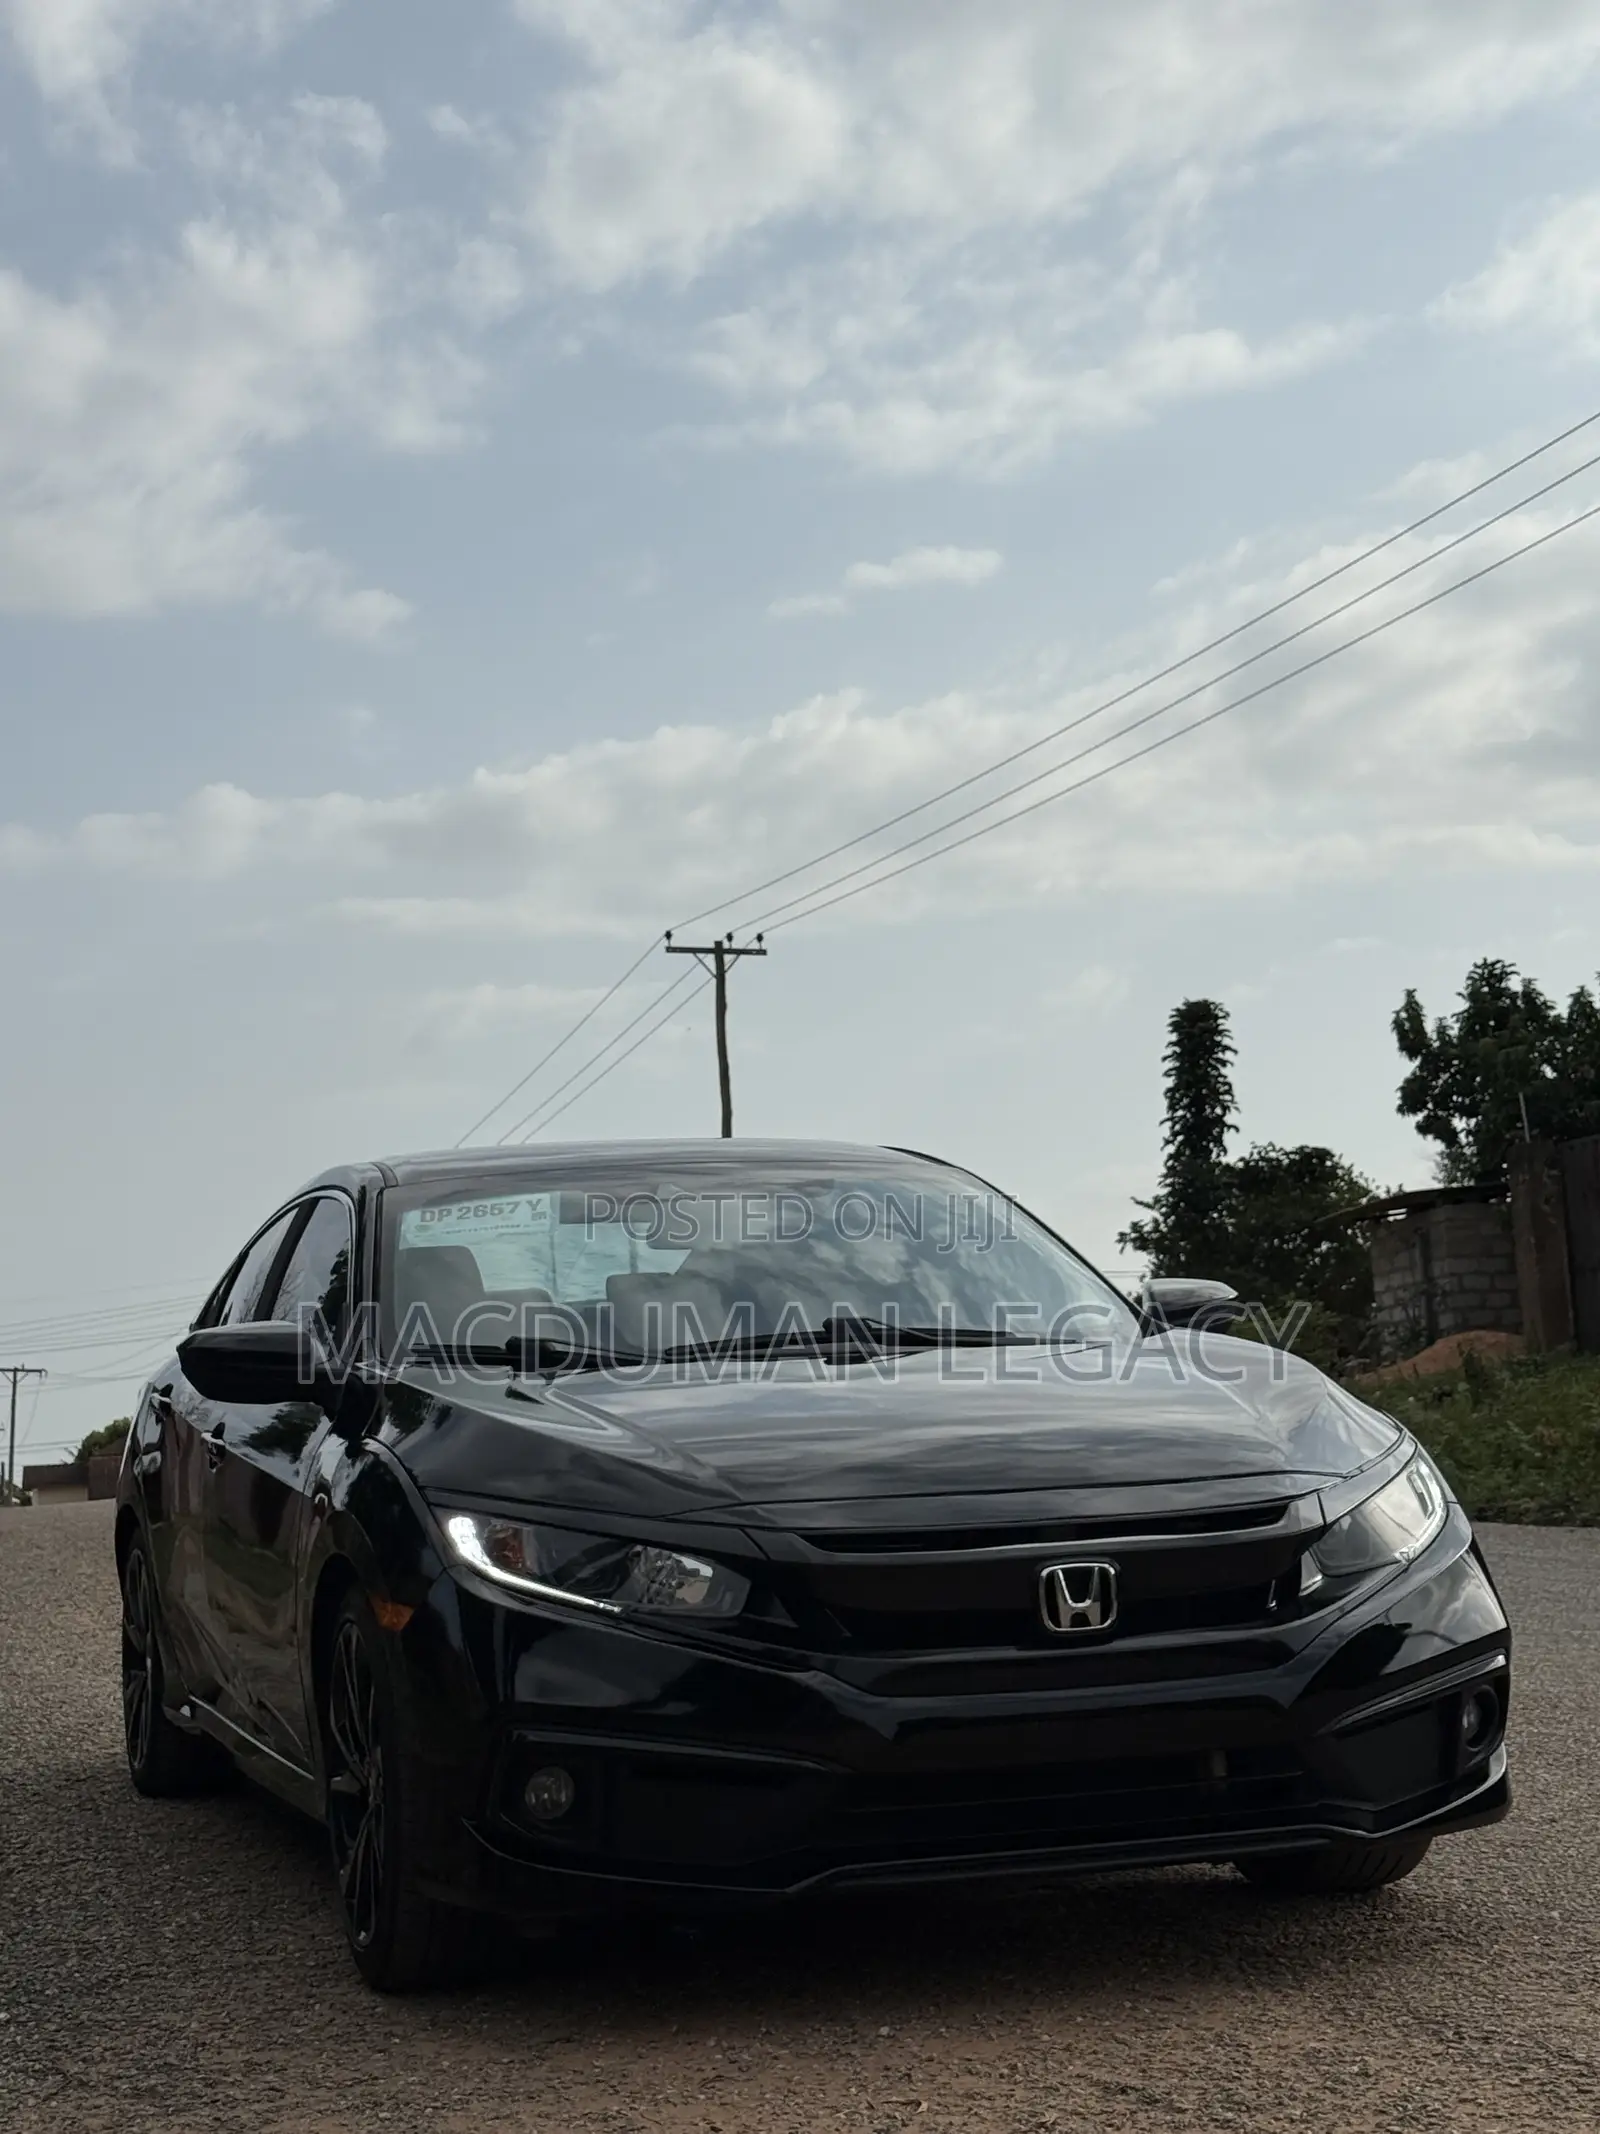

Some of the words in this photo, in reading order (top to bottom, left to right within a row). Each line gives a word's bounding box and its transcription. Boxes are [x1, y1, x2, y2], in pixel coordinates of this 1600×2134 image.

[420, 1208, 452, 1223] DP
[456, 1201, 520, 1220] 2657
[526, 1198, 542, 1212] Y
